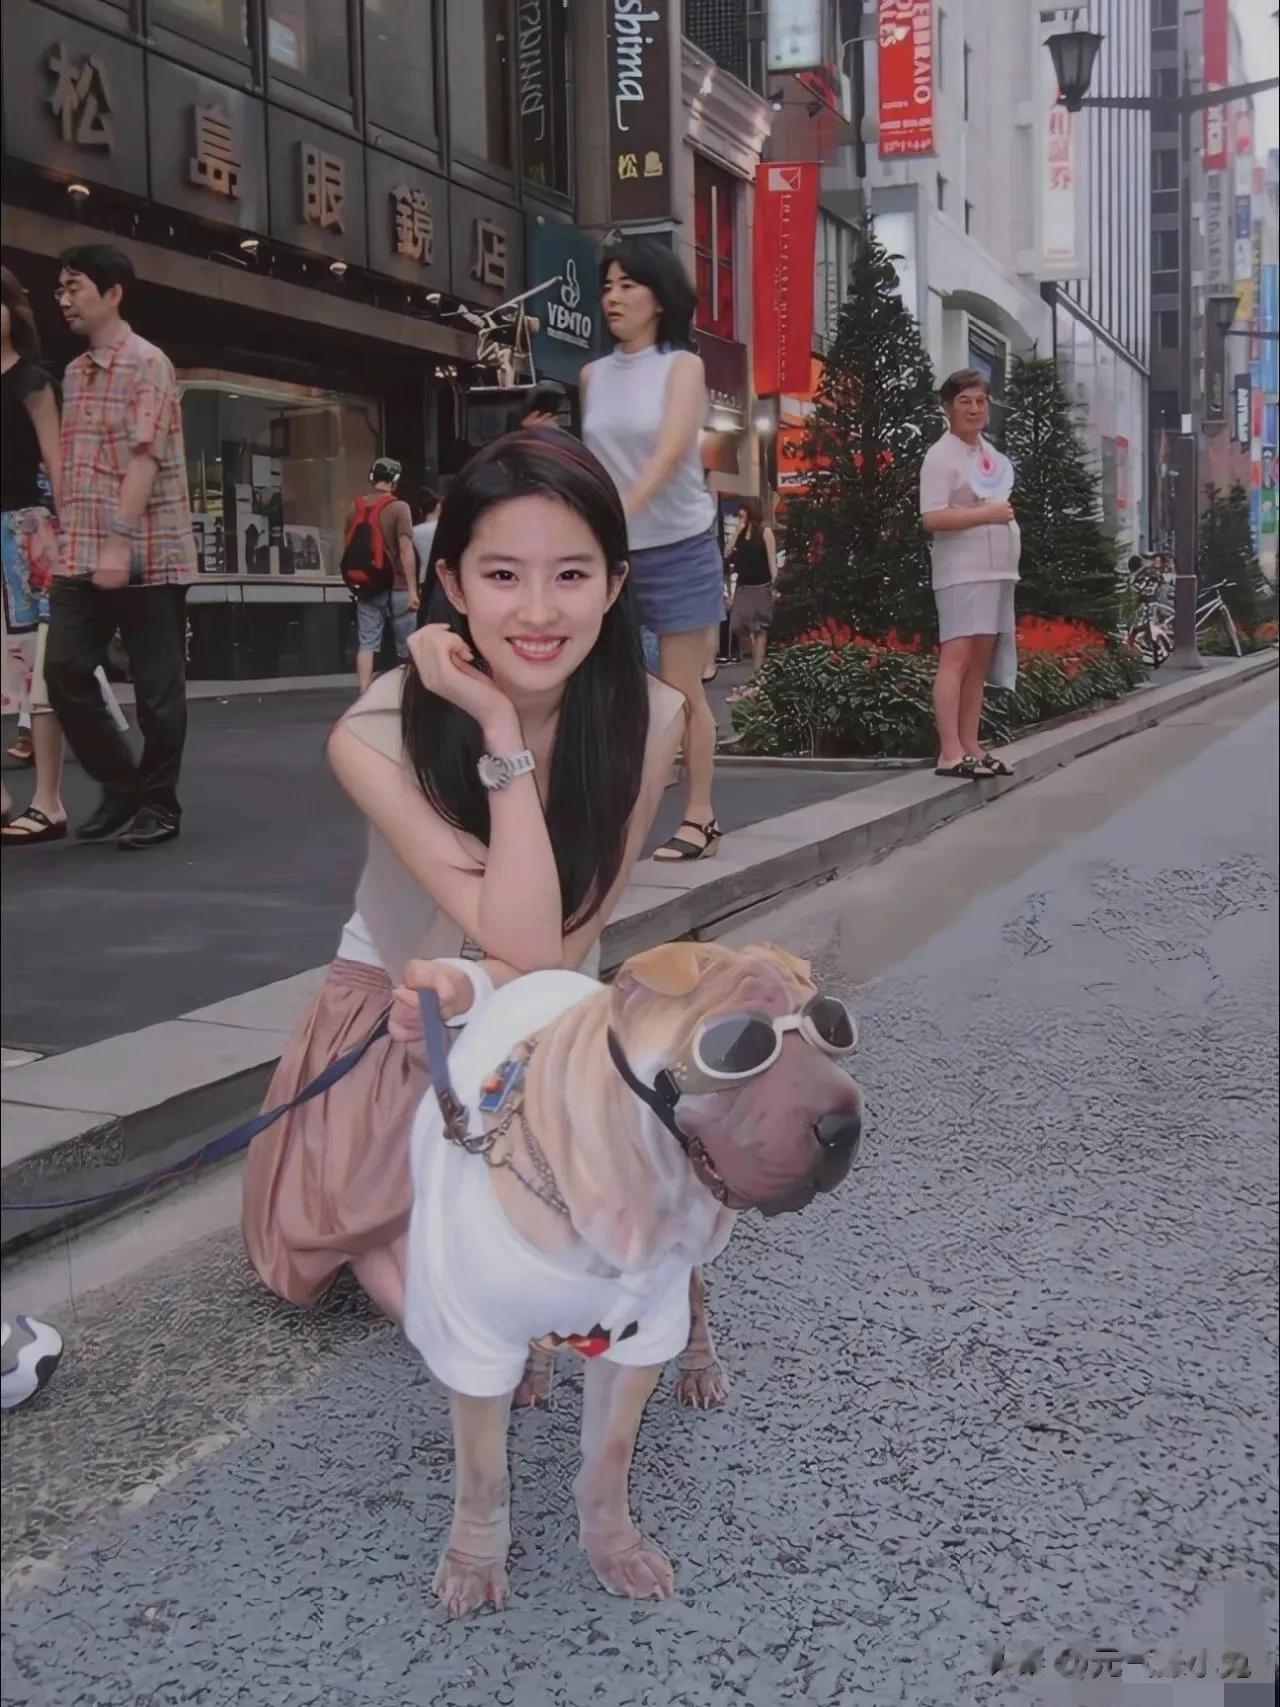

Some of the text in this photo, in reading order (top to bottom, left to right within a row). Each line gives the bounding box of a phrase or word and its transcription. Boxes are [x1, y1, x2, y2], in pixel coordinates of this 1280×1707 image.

[48, 40, 508, 287] 松島眼鏡店
